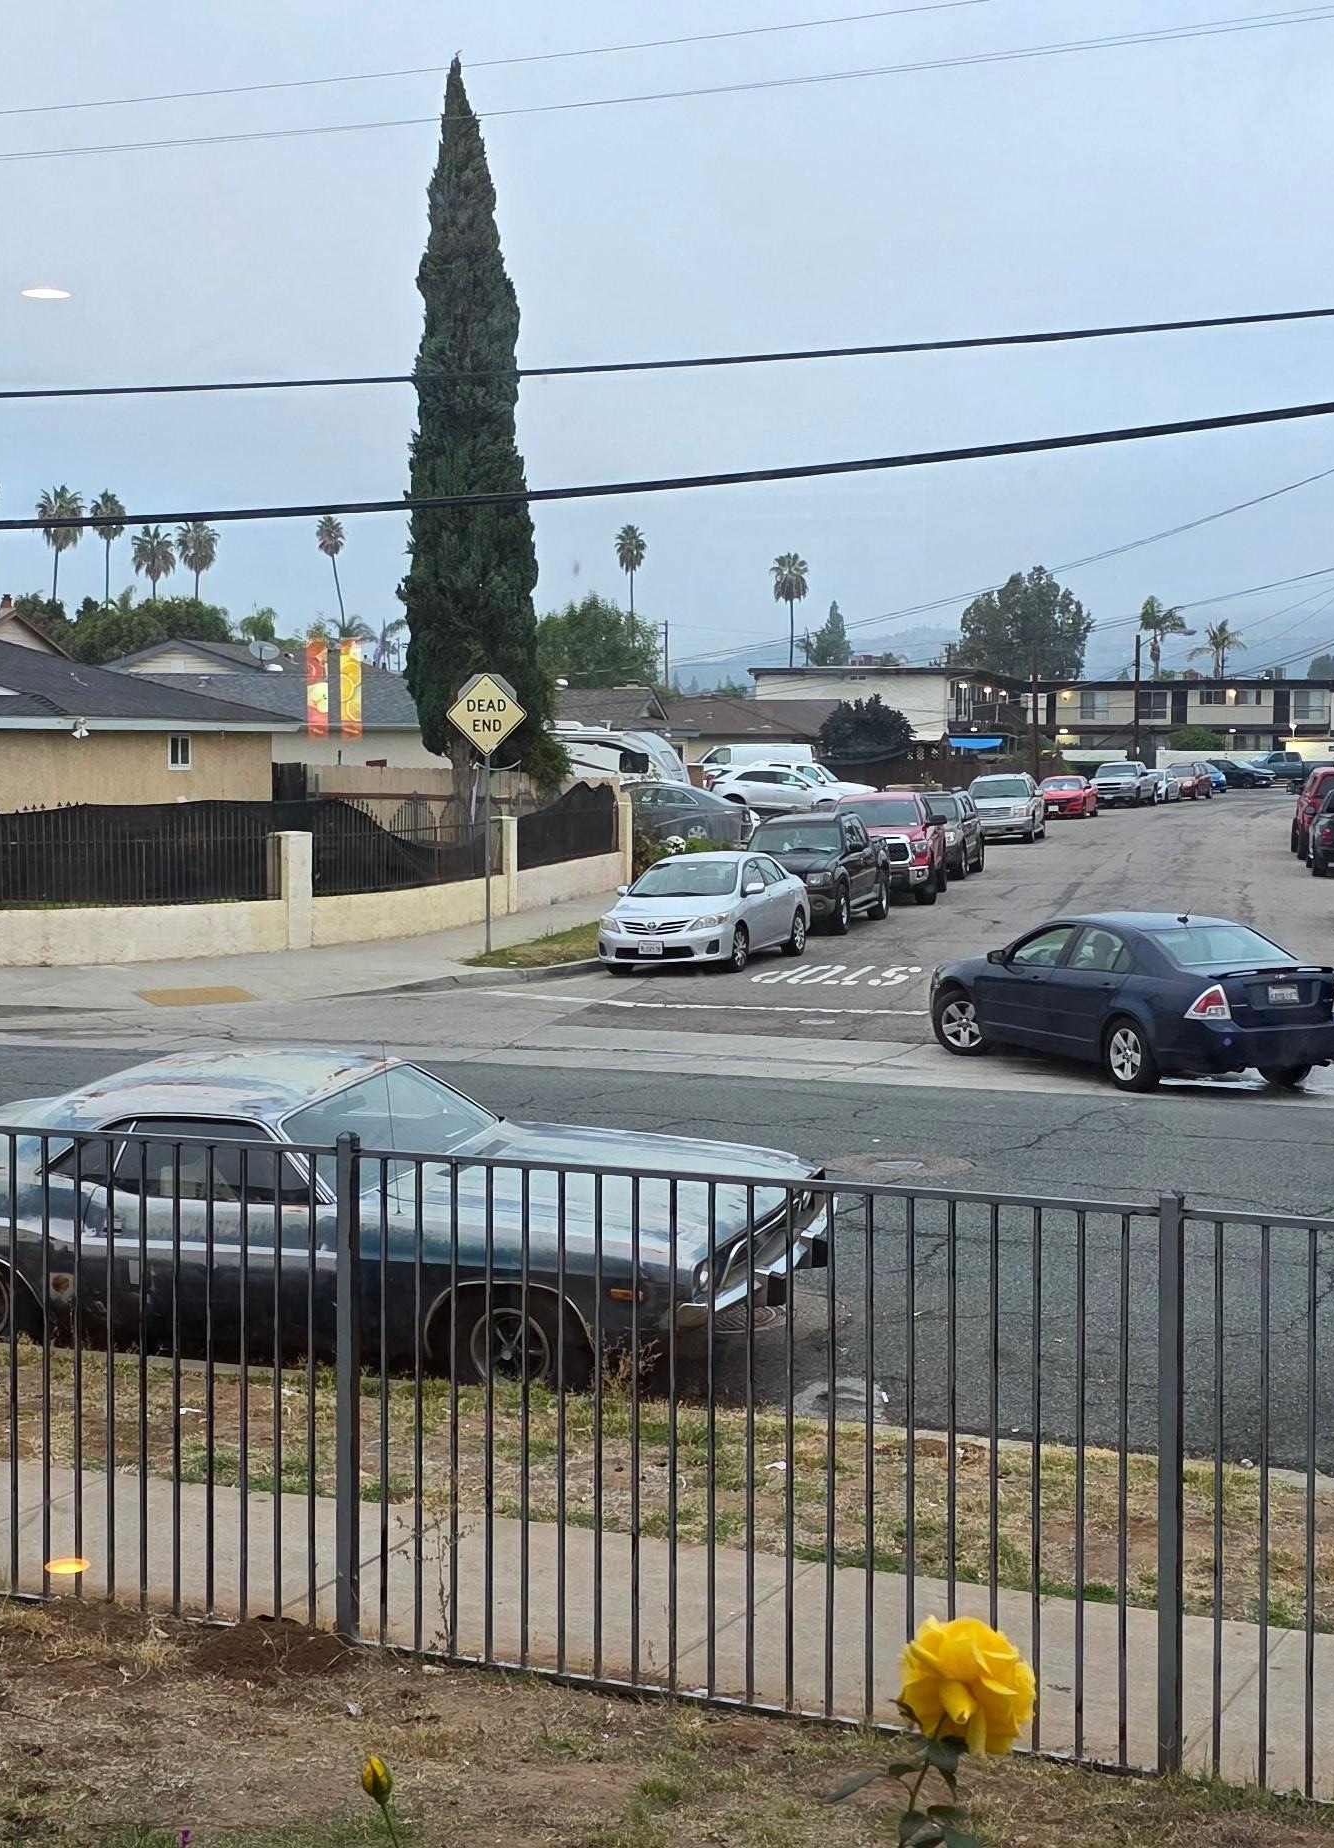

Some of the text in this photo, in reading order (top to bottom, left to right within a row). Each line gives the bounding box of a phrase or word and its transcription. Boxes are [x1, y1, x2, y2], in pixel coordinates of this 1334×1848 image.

[466, 699, 507, 712] DEAD
[472, 719, 502, 732] END
[750, 964, 922, 987] STOP
